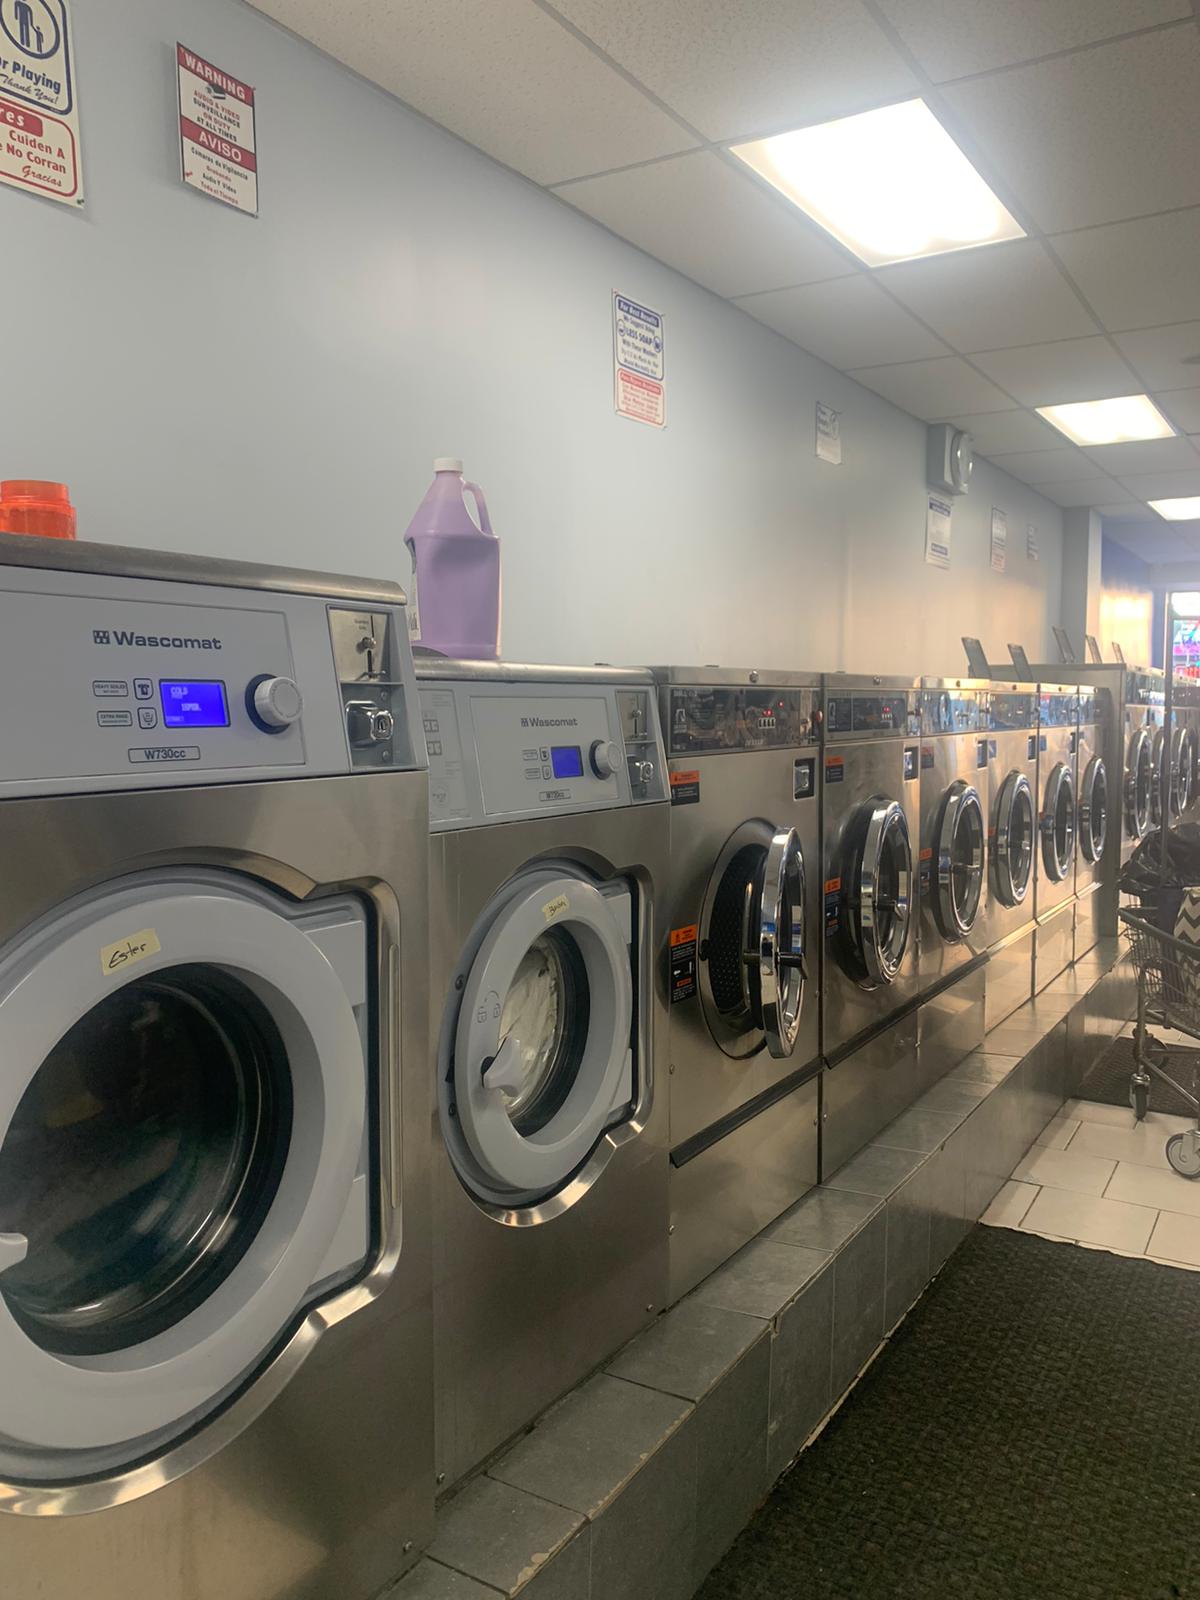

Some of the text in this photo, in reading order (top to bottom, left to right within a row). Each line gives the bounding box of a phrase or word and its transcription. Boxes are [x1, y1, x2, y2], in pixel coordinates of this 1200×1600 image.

[0, 73, 59, 104] Thank You!
[12, 61, 61, 95] Playing
[184, 52, 245, 100] WARNING
[193, 97, 240, 128] SURVEILLANCE
[194, 89, 214, 106] AUDIO
[221, 105, 240, 120] VIDEO
[203, 111, 231, 131] ON DUTY
[205, 121, 217, 132] ALL
[218, 126, 237, 142] TIMES
[9, 130, 52, 154] Cuiden
[57, 148, 65, 159] A
[200, 131, 242, 161] AVISO
[6, 143, 23, 158] No
[27, 151, 66, 174] Corran
[22, 165, 62, 187] Gracias
[203, 173, 216, 184] Audio
[620, 301, 628, 312] For
[113, 630, 222, 650] Wascomat
[529, 717, 578, 727] Wascomat
[144, 748, 186, 760] W730cc
[108, 942, 147, 969] Ester
